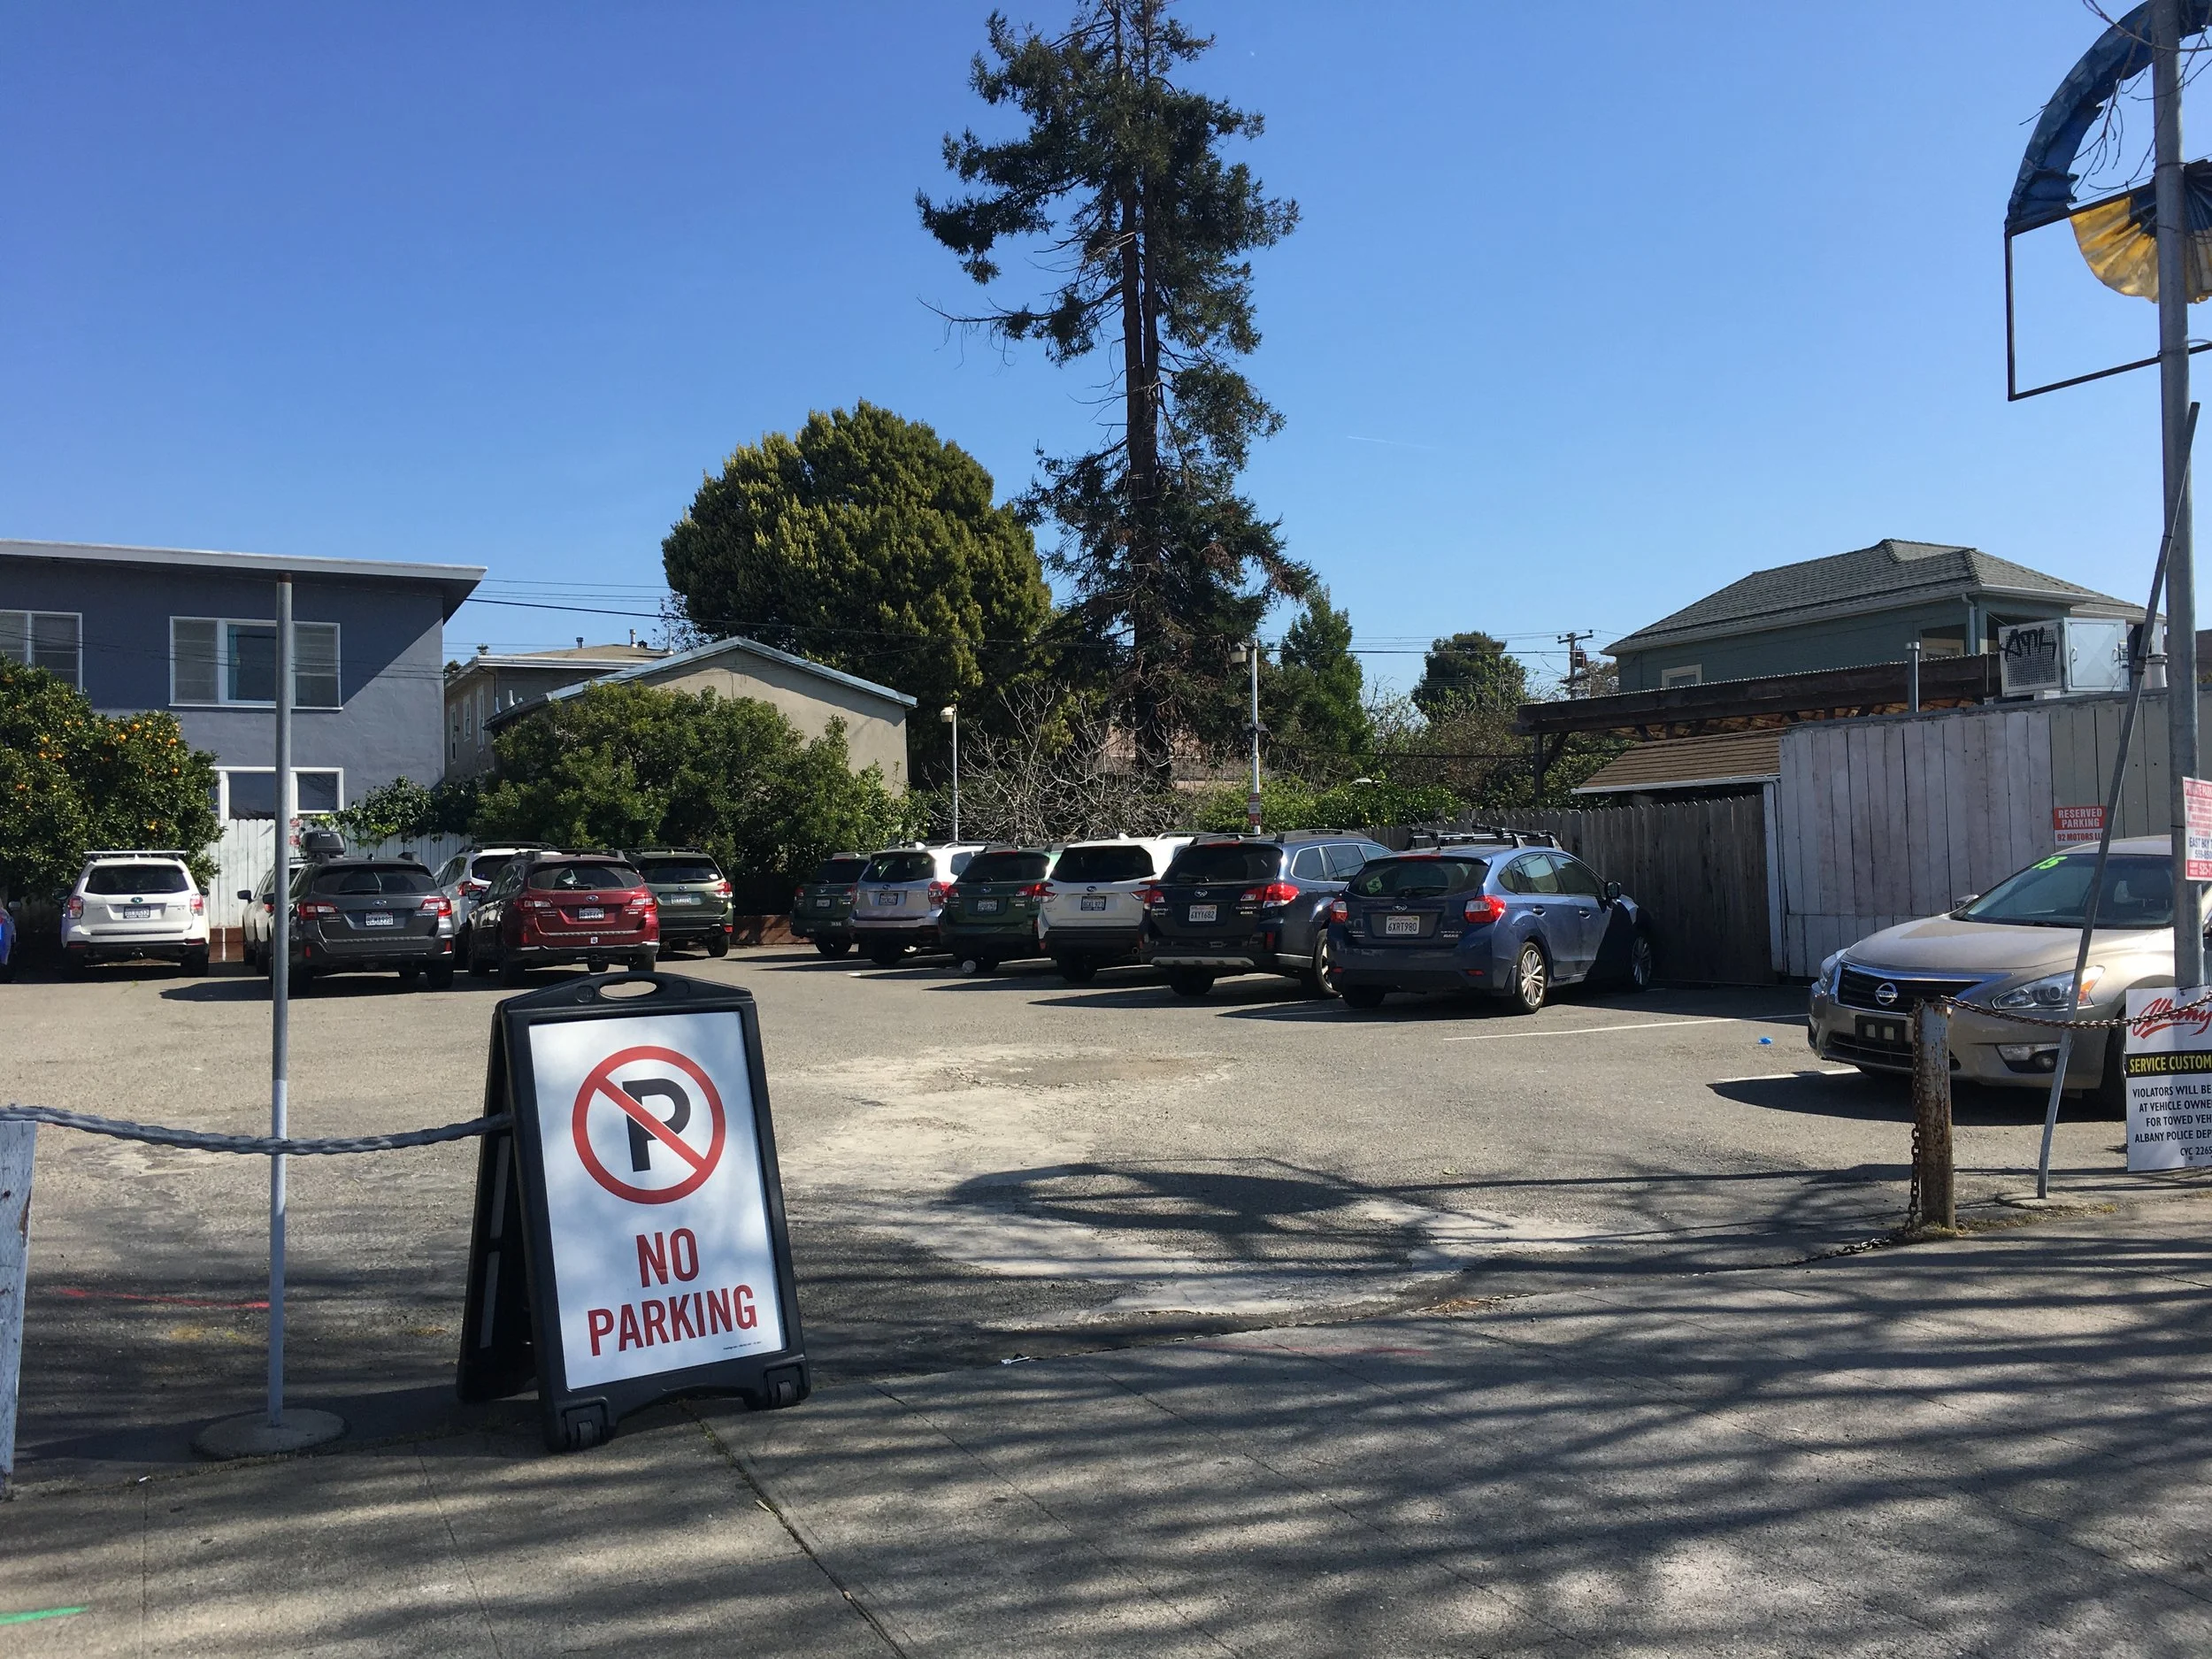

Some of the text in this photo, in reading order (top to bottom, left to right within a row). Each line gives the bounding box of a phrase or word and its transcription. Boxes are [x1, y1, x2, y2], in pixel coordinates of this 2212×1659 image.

[2058, 808, 2102, 818] RESERVED
[2062, 818, 2100, 828] PARKING
[2067, 833, 2094, 841] MOTORS
[2094, 832, 2103, 841] LL
[2189, 837, 2200, 848] EAST
[2129, 1054, 2212, 1073] SERVICE CUSTOM
[2132, 1085, 2211, 1098] VIOLATORS WILL BE
[2139, 1099, 2212, 1113] AT VEHICLE OWNE
[622, 1078, 691, 1172] P
[2146, 1114, 2212, 1127] FOR TOWED VEH
[2134, 1129, 2212, 1143] ALBANY POLICE DEP
[636, 1227, 699, 1288] NO
[588, 1285, 757, 1356] PARKING
